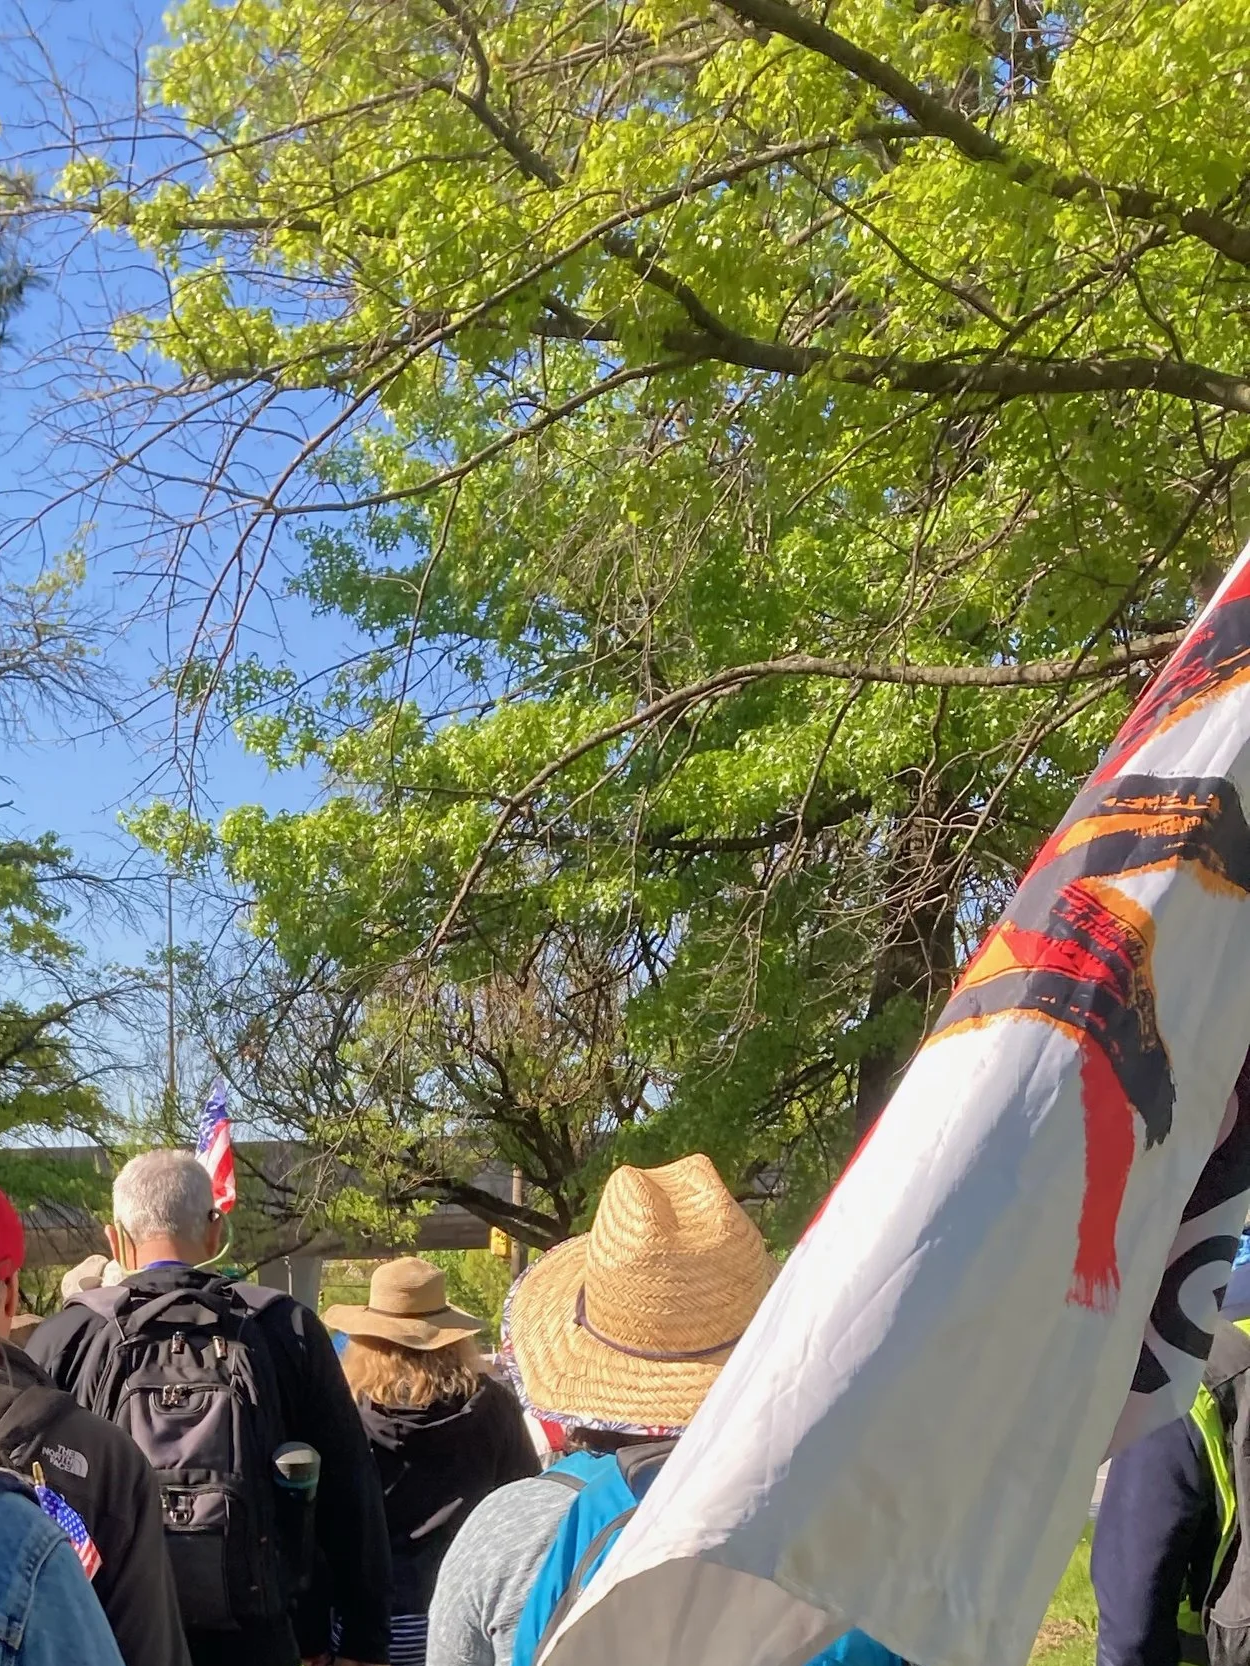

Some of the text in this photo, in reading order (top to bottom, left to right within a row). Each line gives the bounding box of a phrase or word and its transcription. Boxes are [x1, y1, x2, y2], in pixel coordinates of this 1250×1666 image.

[41, 1446, 73, 1465] NORTH
[57, 1443, 76, 1458] THE
[49, 1455, 72, 1473] FACE
